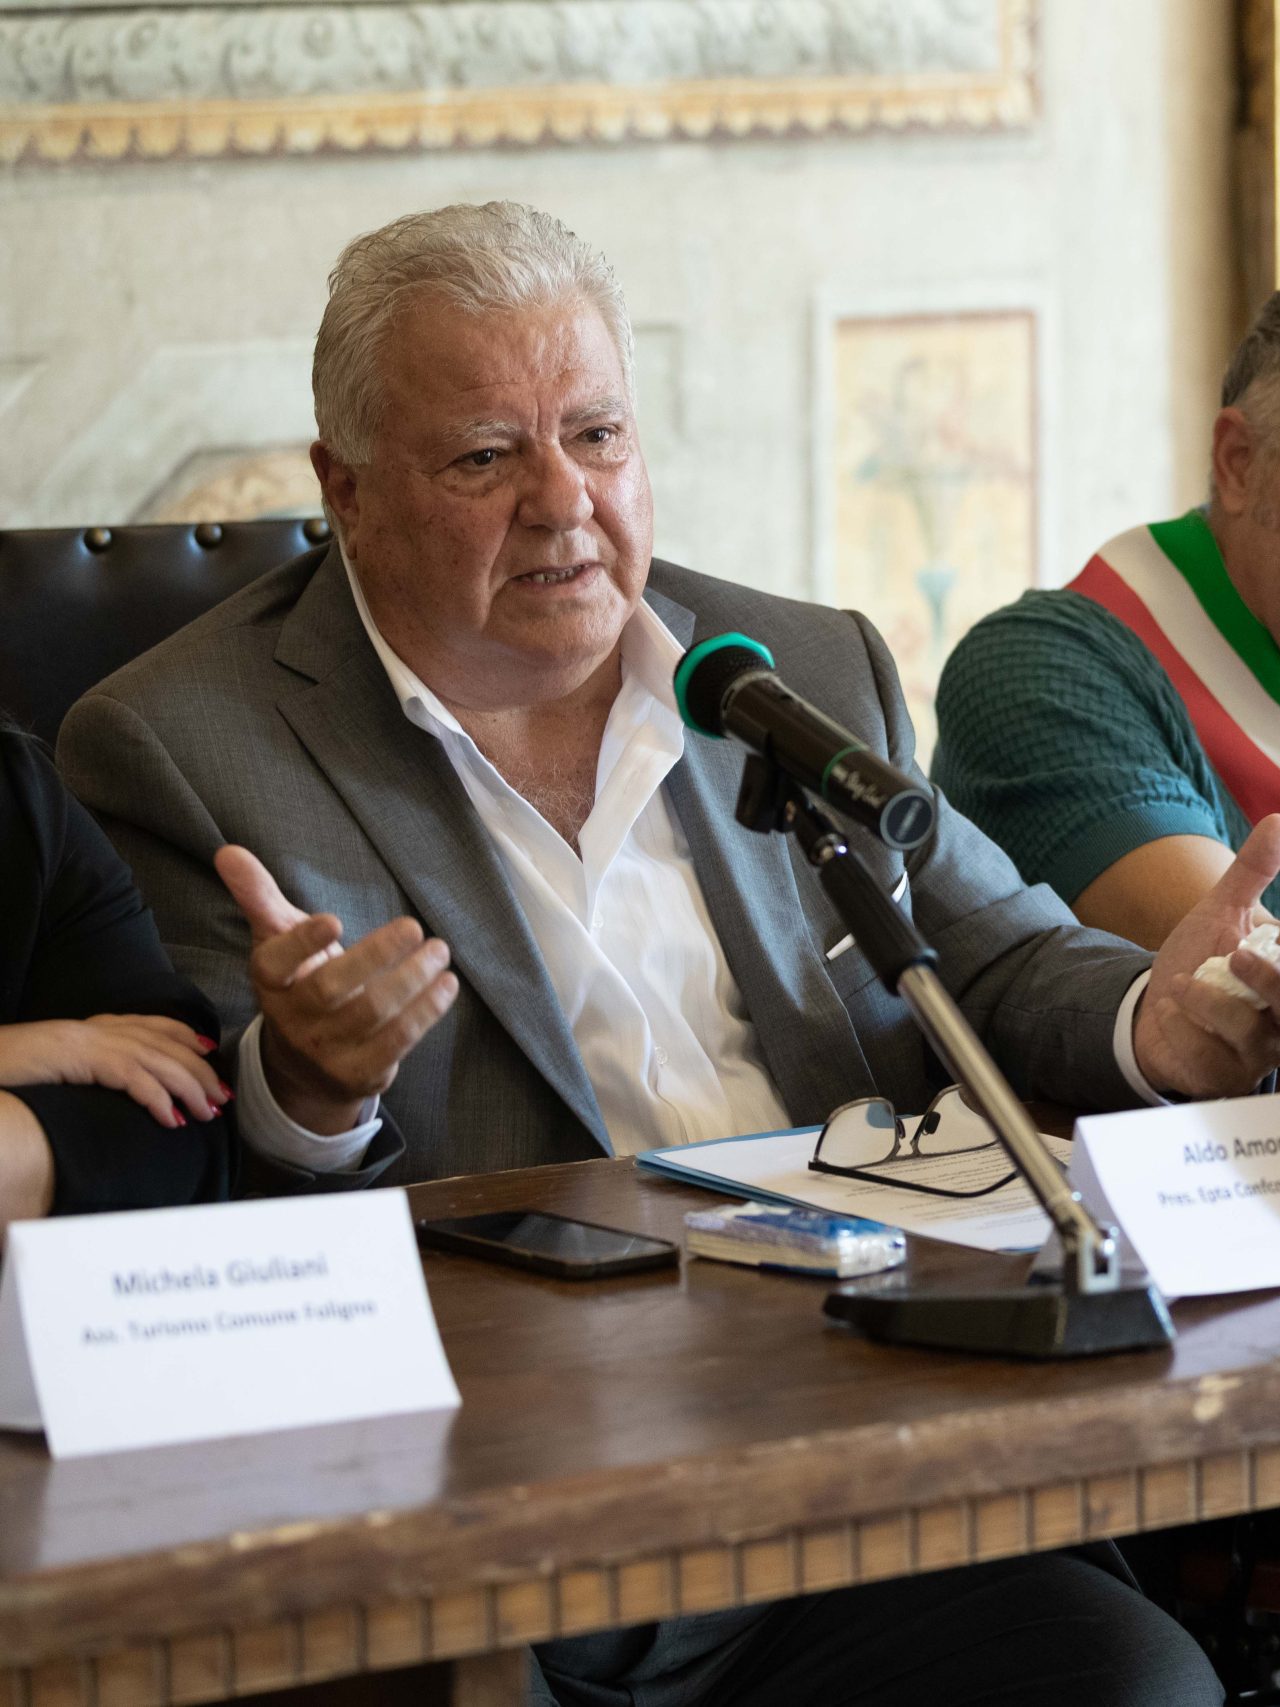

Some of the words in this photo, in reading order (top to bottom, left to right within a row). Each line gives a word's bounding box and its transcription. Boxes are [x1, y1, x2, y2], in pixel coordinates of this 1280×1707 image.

[1182, 1141, 1229, 1165] Aldo
[1157, 1191, 1196, 1209] Pres.
[112, 1263, 219, 1297] Michela
[225, 1253, 329, 1288] Giuliani
[129, 1318, 210, 1343] Turismo
[214, 1310, 298, 1333] Comune
[302, 1299, 377, 1322] Foligno
